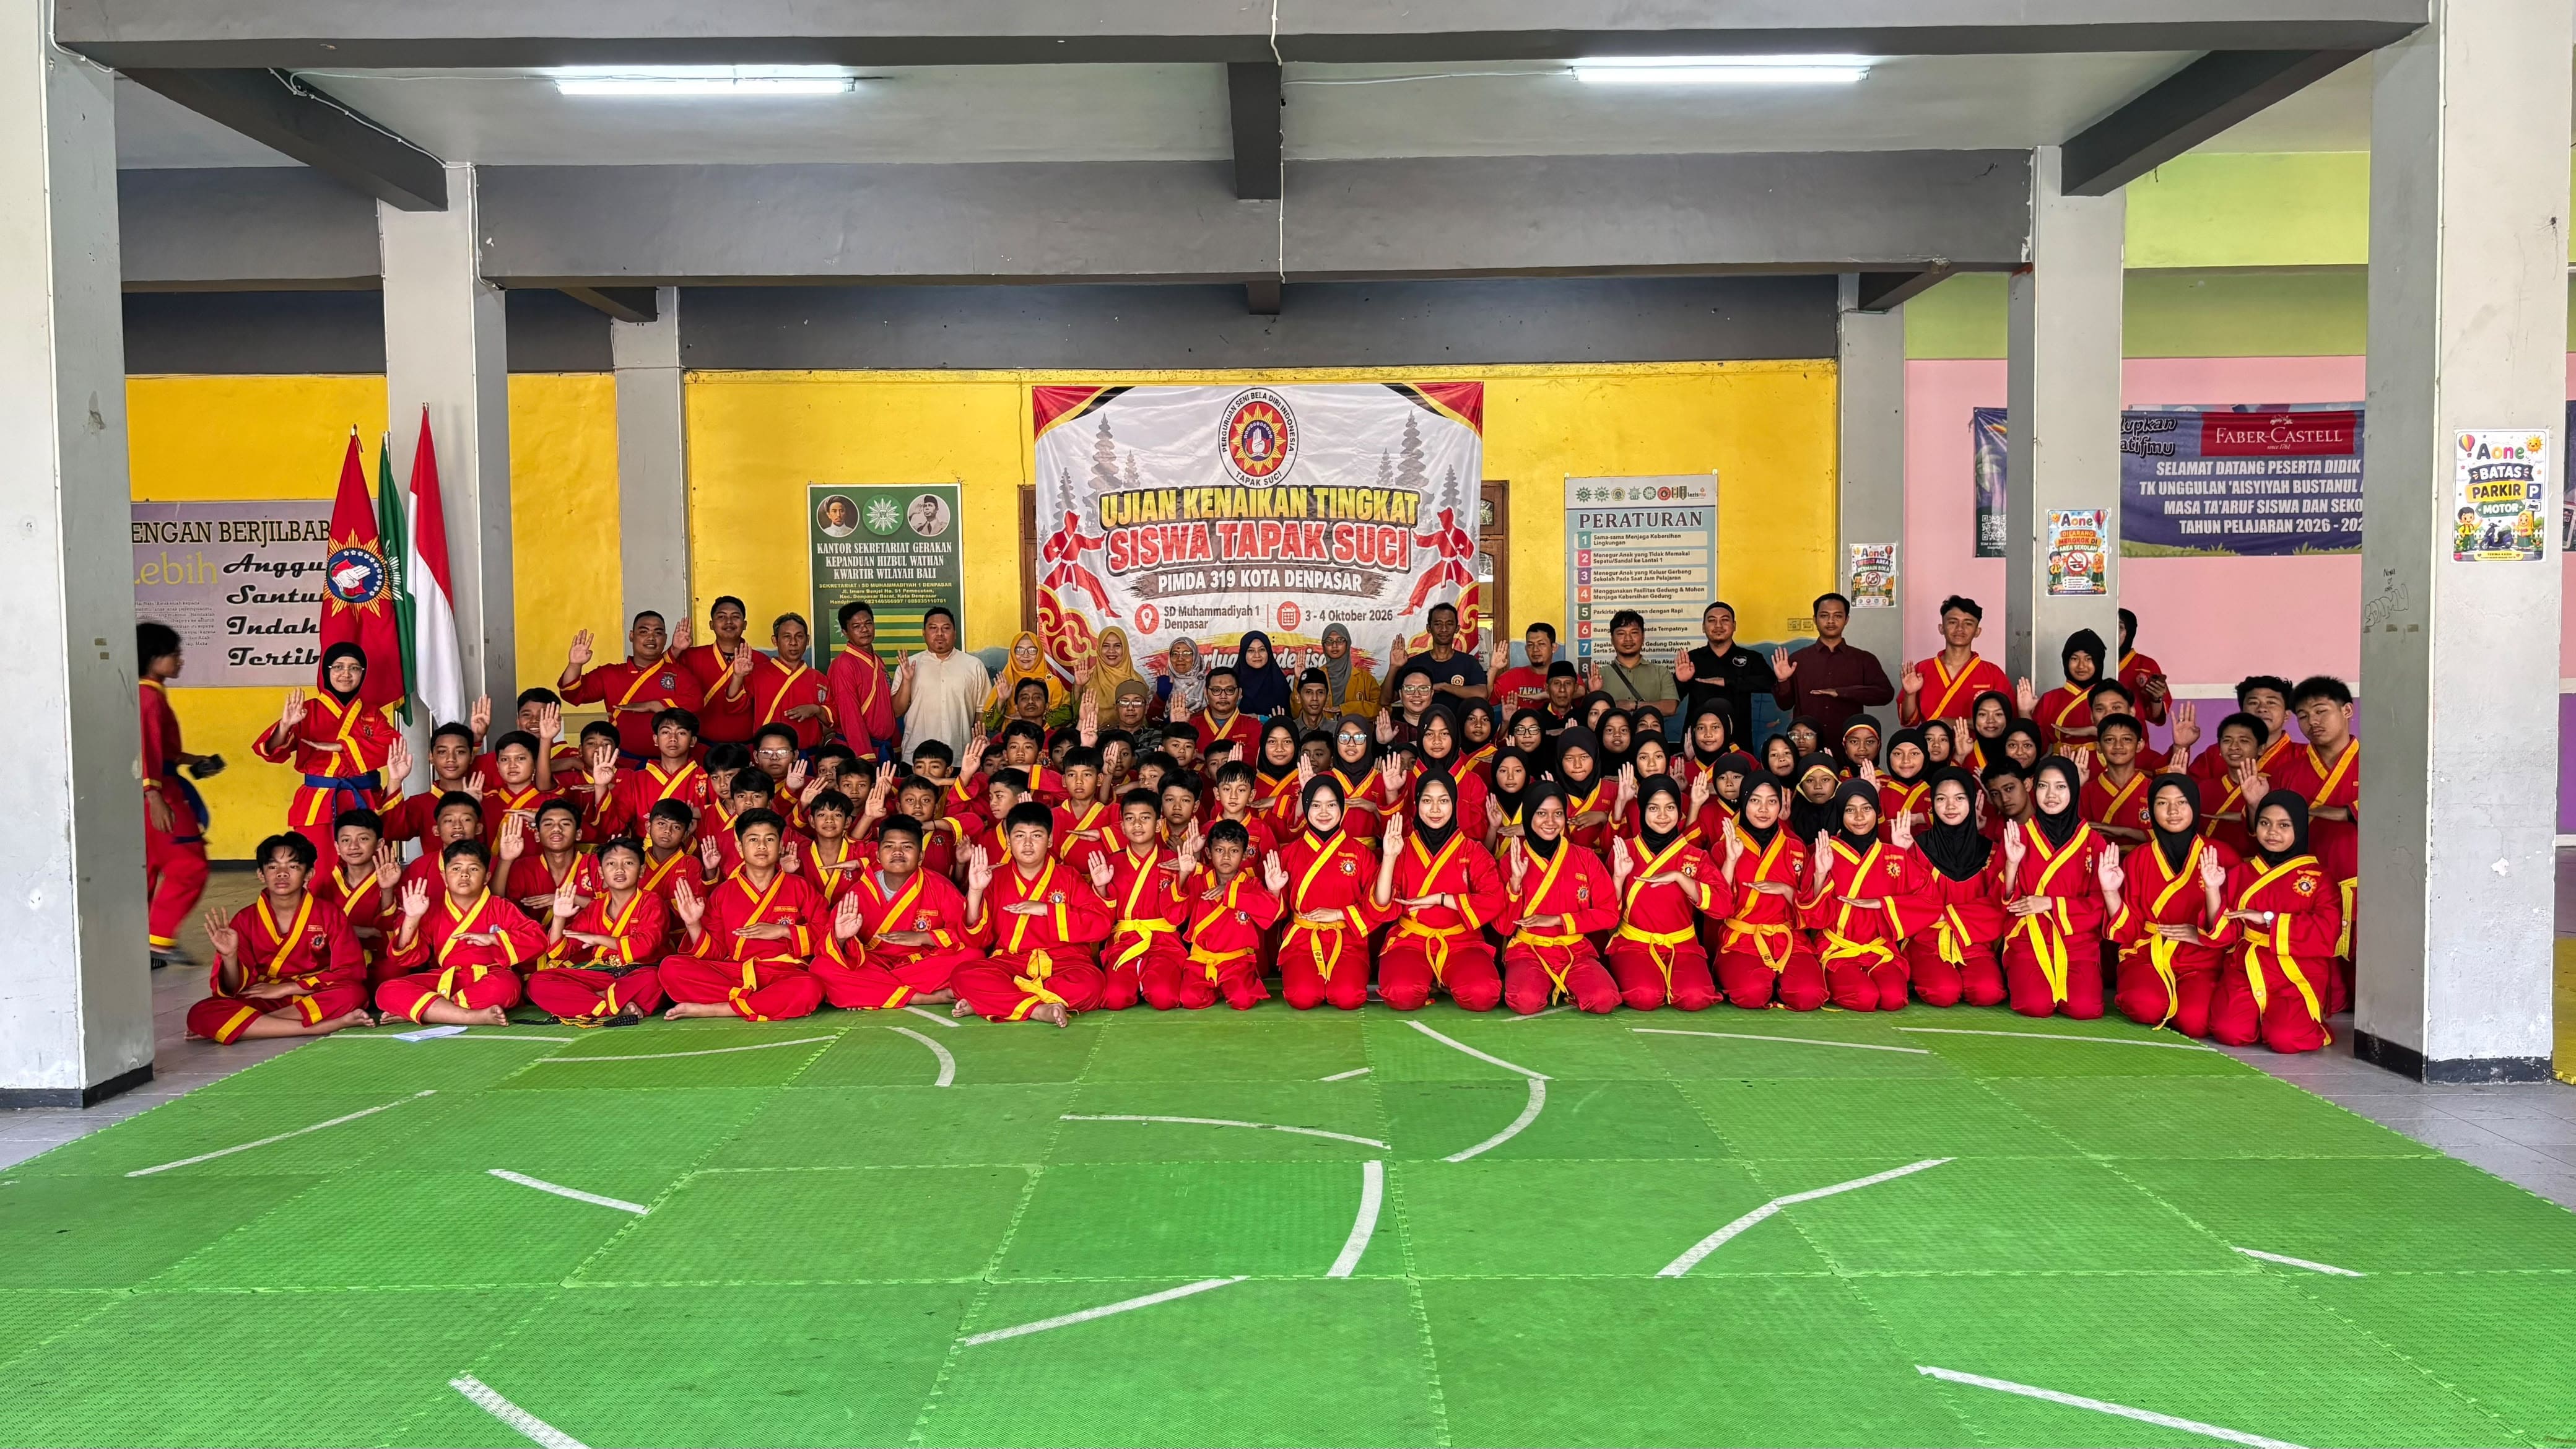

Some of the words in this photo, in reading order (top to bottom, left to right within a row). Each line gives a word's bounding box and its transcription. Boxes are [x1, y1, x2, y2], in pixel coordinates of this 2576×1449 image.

[1222, 405, 1237, 453] PERGURUAN
[1236, 394, 1250, 407] SENI
[1251, 392, 1267, 400] BELA
[1268, 395, 1281, 407] DIRI
[1280, 406, 1295, 451] INDONESIA
[2216, 427, 2343, 443] FABER-CASTELL
[2477, 443, 2525, 459] Aone
[2156, 461, 2213, 476] SELAMAT
[2216, 461, 2265, 475] DATANG
[2268, 460, 2321, 474] PESERTA
[2324, 459, 2362, 473] DIDIK
[2479, 466, 2522, 480] BATAS
[1236, 471, 1261, 486] TAPAK
[1264, 471, 1282, 485] SUCI
[2139, 481, 2156, 495] TK
[2159, 481, 2226, 495] UNGGULAN
[2229, 480, 2289, 494] 'AISYIYAH
[2293, 479, 2357, 494] BUSTANUL
[2473, 484, 2522, 499] PARKIR
[2530, 485, 2539, 497] P
[1101, 490, 1175, 527] UJIAN
[1183, 487, 1307, 520] KENAIKAN
[1313, 488, 1420, 524] TINGKAT
[2164, 500, 2200, 515] MASA
[2204, 500, 2255, 514] TA'ARUF
[2256, 500, 2299, 514] SISWA
[2302, 499, 2328, 513] DAN
[2331, 498, 2363, 513] SEKO
[2483, 503, 2518, 513] MOTOR
[1579, 511, 1702, 528] PERATURAN
[2061, 513, 2093, 526] Aone
[2179, 520, 2221, 534] TAHUN
[2224, 519, 2293, 533] PELAJARAN
[2295, 519, 2330, 533] 2026
[2341, 518, 2362, 532] 202
[132, 521, 212, 543] ENGAN
[219, 521, 331, 547] BERJILBAB
[1582, 536, 1587, 544] 1
[817, 543, 851, 554] KANTOR
[854, 542, 910, 553] SEKRETARIAT
[913, 542, 952, 553] GERAKAN
[1109, 523, 1211, 570] SISWA
[1219, 522, 1326, 560] TAPAK
[1333, 524, 1409, 568] SUCI
[1861, 548, 1884, 557] Aone
[223, 553, 326, 578] Anggu
[826, 556, 874, 567] KEPANDUAN
[877, 555, 907, 567] HIZBUL
[910, 555, 944, 566] WATHAN
[1582, 554, 1588, 562] 2
[134, 551, 219, 585] ebih
[834, 569, 874, 580] KWARTIR
[876, 568, 913, 579] WILAYAH
[916, 568, 936, 578] BALI
[1159, 572, 1206, 592] PIMDA
[1211, 570, 1235, 588] 319
[1241, 569, 1280, 588] KOTA
[1285, 570, 1362, 591] DENPASAR
[1581, 572, 1588, 580] 3
[226, 585, 324, 604] Santu
[1581, 589, 1588, 598] 4
[1164, 606, 1176, 617] SD
[1178, 605, 1253, 619] Muhammadiyah
[1255, 606, 1260, 616] 1
[1305, 611, 1311, 621] 3
[1320, 611, 1326, 620] 4
[1328, 610, 1367, 621] Oktober
[1368, 609, 1393, 620] 2026
[1582, 607, 1588, 617] 5
[227, 616, 321, 635] Indah
[1164, 619, 1209, 632] Denpasar
[1582, 625, 1588, 634] 6
[1582, 643, 1588, 653] 7
[228, 647, 321, 666] Tertib
